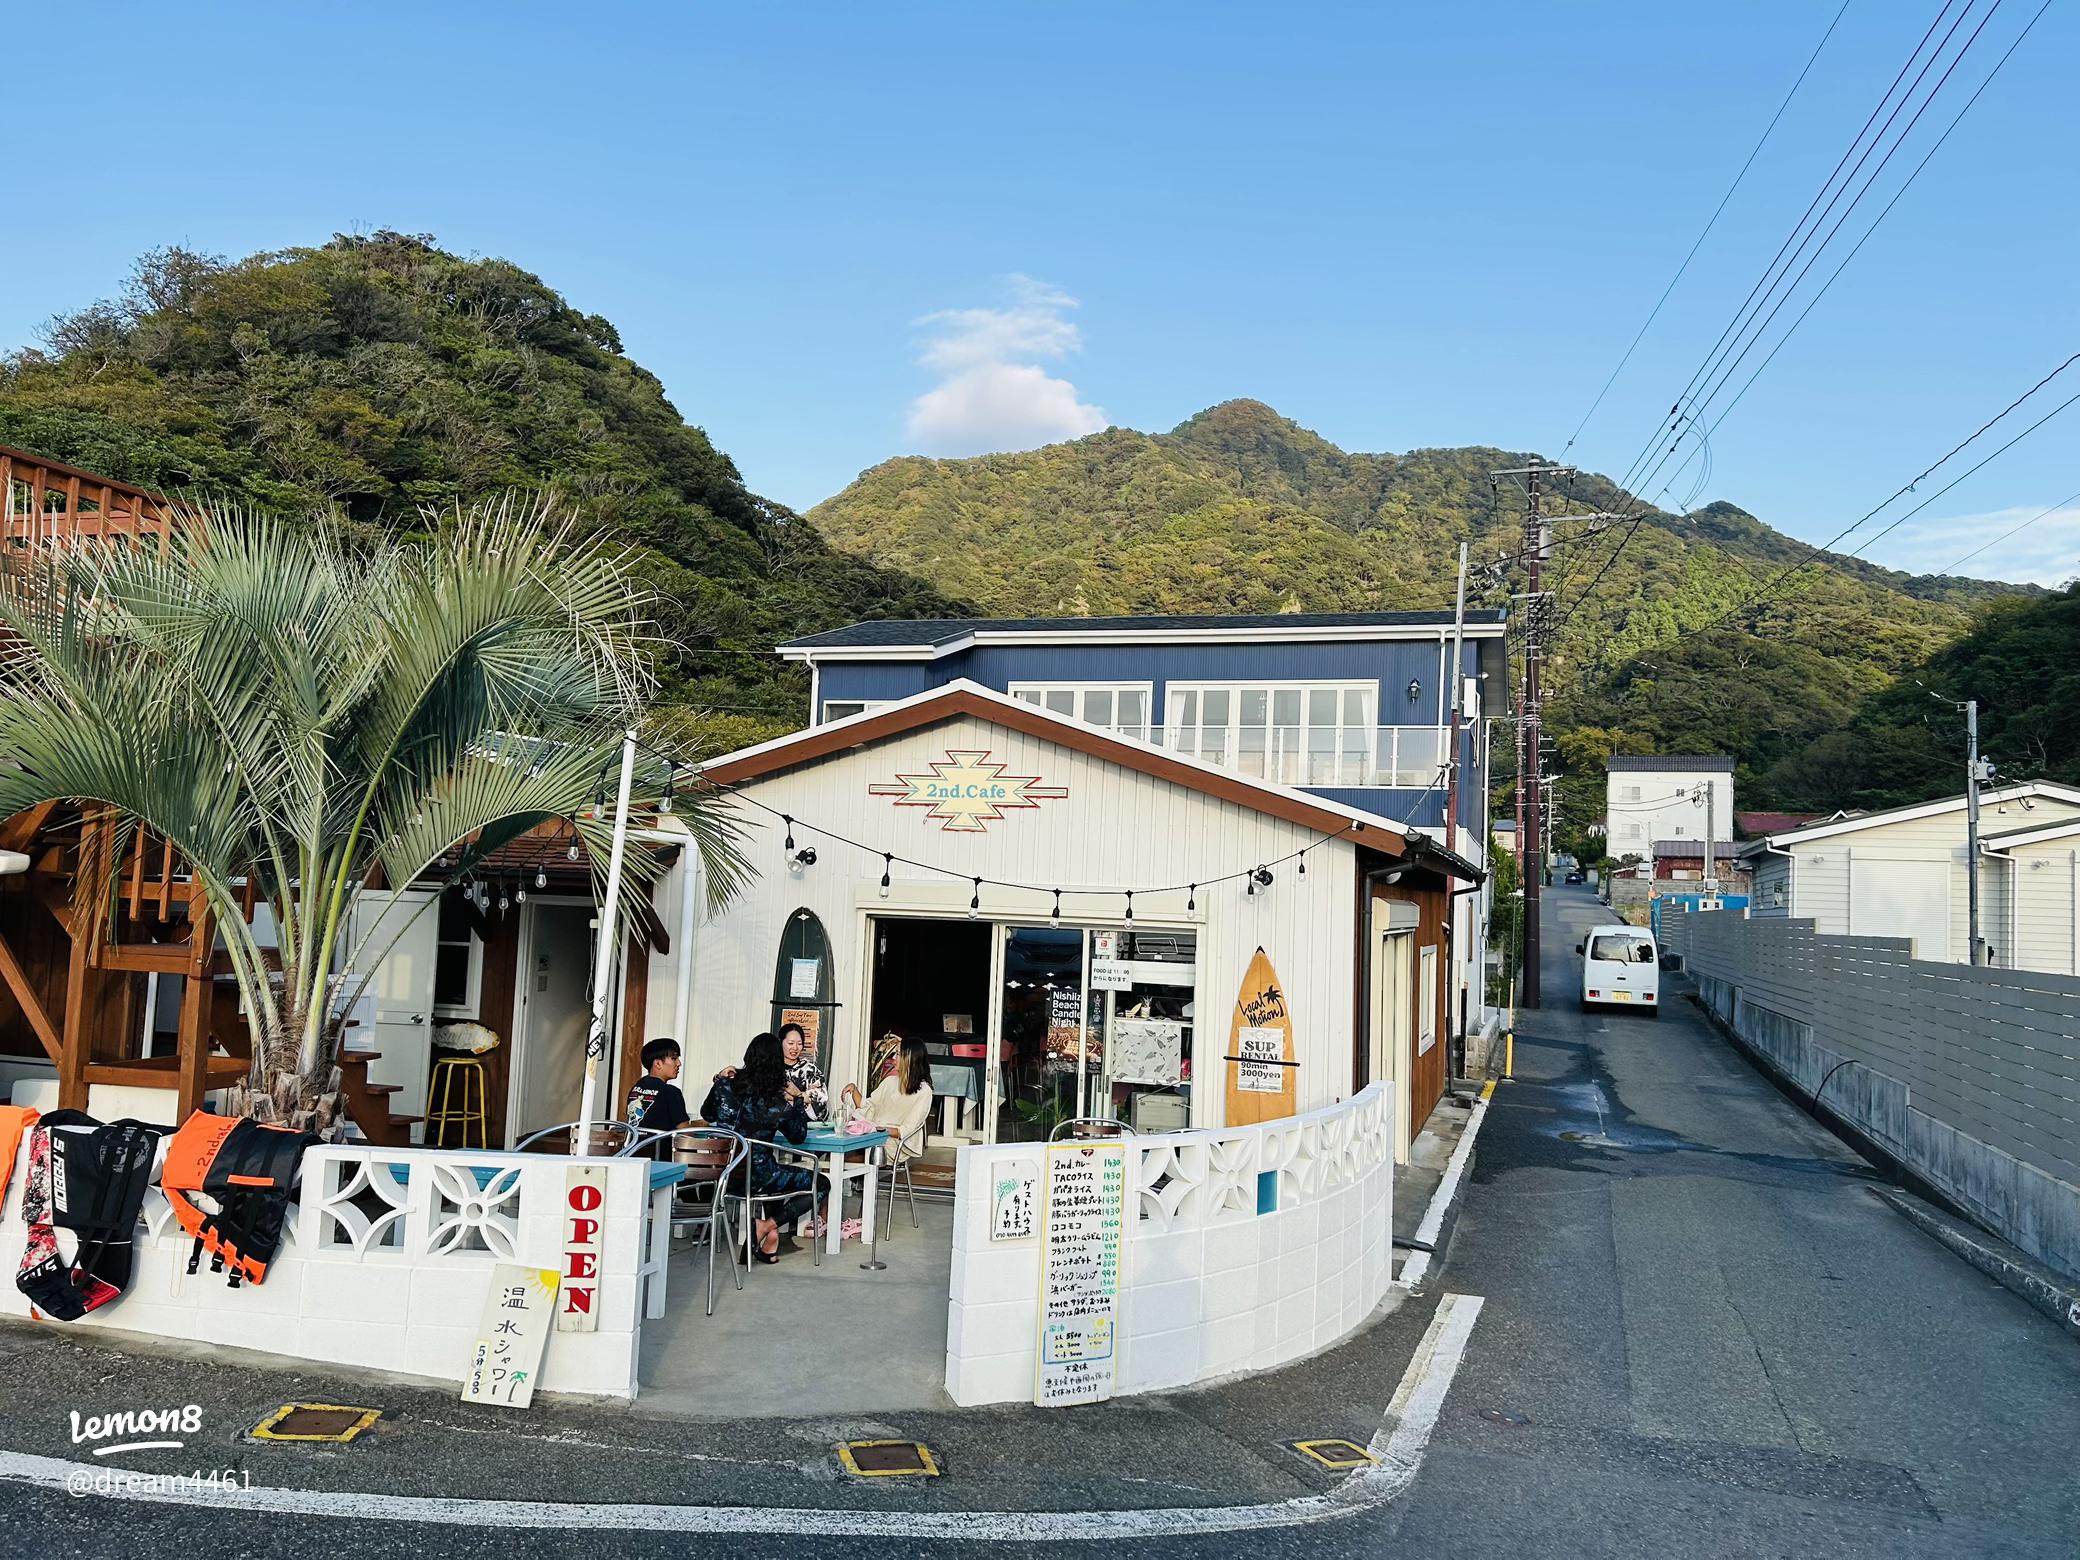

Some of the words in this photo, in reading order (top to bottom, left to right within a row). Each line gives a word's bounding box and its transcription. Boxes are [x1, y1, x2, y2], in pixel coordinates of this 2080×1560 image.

[926, 783, 1007, 799] 2nd.Cafe
[1053, 991, 1082, 1002] Nishiiz
[1052, 1000, 1080, 1010] Beach
[1238, 991, 1266, 1016] Local
[1051, 1017, 1075, 1028] Night
[1246, 1008, 1280, 1028] Motion
[1244, 1040, 1277, 1053] SUP
[1240, 1051, 1281, 1061] RENTAL
[1240, 1062, 1269, 1070] 90min
[1240, 1069, 1281, 1080] 3000yen
[1104, 1158, 1121, 1167] 1430
[1053, 1172, 1094, 1183] TACOライス
[1103, 1172, 1121, 1180] 1430
[1053, 1184, 1092, 1194] ガパオライス
[1103, 1184, 1121, 1193] 1430
[1102, 1196, 1120, 1204] 1430
[1023, 1179, 1035, 1235] ゲストハウス
[1102, 1207, 1120, 1216] 1430
[1051, 1222, 1082, 1232] ロコモコ
[1101, 1220, 1120, 1228] 1560
[1101, 1233, 1119, 1241] 1210
[563, 1185, 602, 1314] OPEN
[1051, 1244, 1087, 1256] フランクフルト
[1051, 1255, 1092, 1268] フレンチポテト
[1101, 1269, 1117, 1278] 990
[1050, 1283, 1083, 1295] 浜バーガー
[490, 1286, 530, 1396] 温水シャワー
[1064, 1361, 1089, 1373] 不定休
